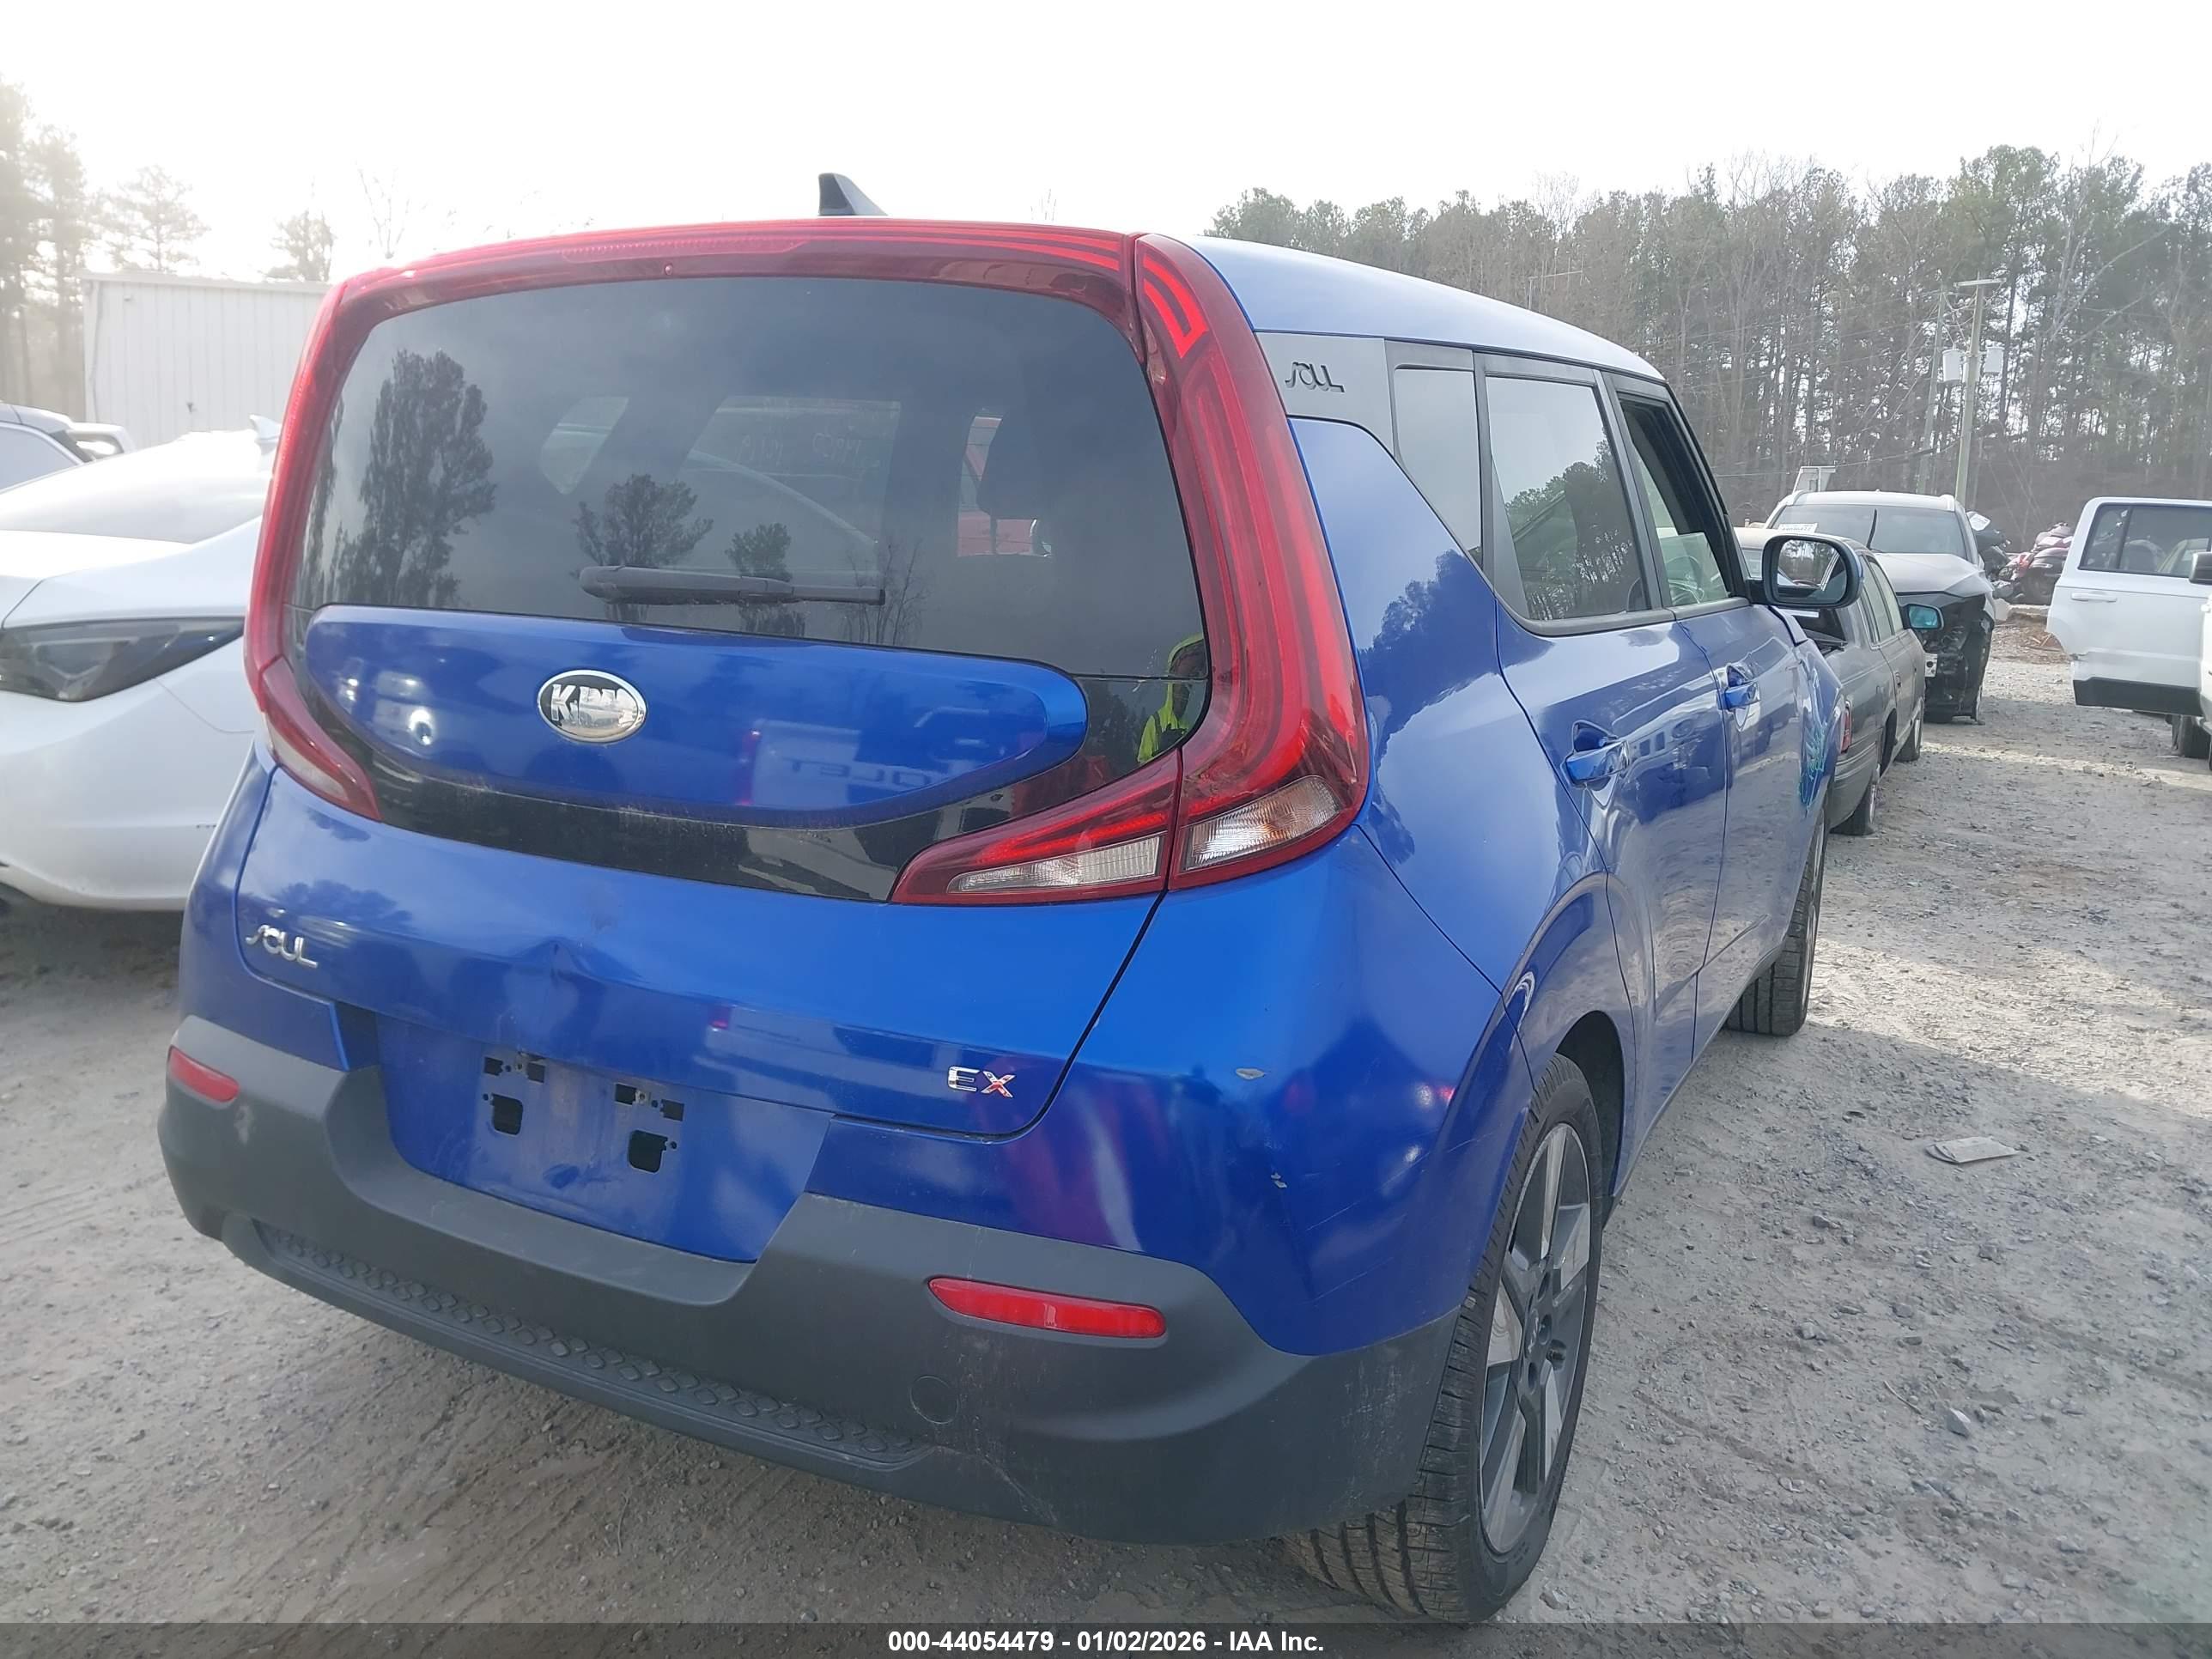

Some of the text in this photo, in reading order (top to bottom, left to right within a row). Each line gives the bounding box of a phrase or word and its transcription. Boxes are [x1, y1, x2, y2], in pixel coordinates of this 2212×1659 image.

[1285, 362, 1345, 392] SOUL
[246, 924, 318, 969] SOUL
[948, 1066, 1016, 1098] EX
